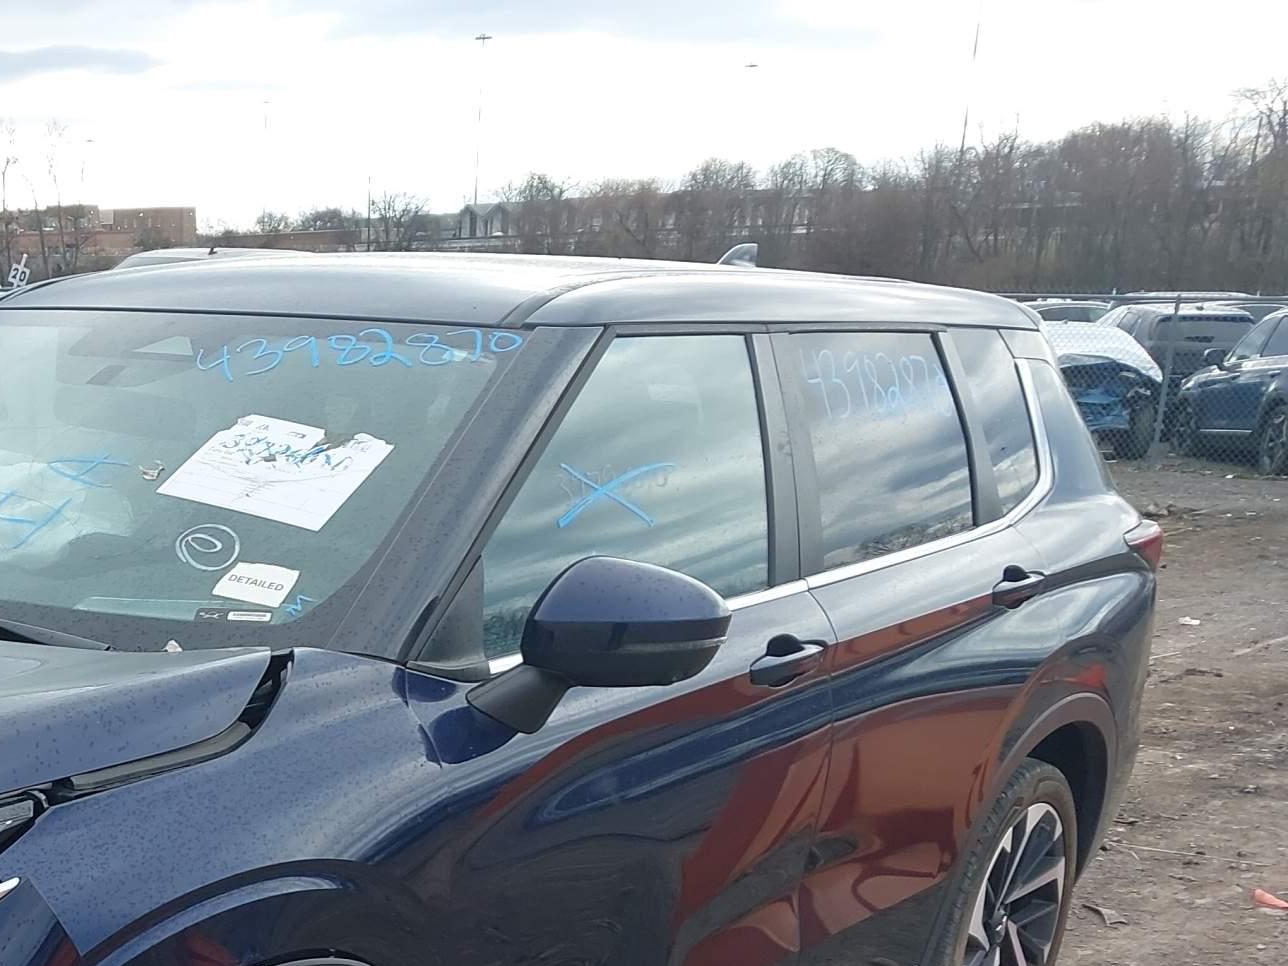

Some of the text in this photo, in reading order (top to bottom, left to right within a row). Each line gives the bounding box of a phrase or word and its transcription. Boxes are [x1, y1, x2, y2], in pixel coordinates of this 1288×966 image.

[11, 267, 27, 282] 20
[195, 328, 524, 382] 43982870
[227, 574, 285, 592] DETAILED
